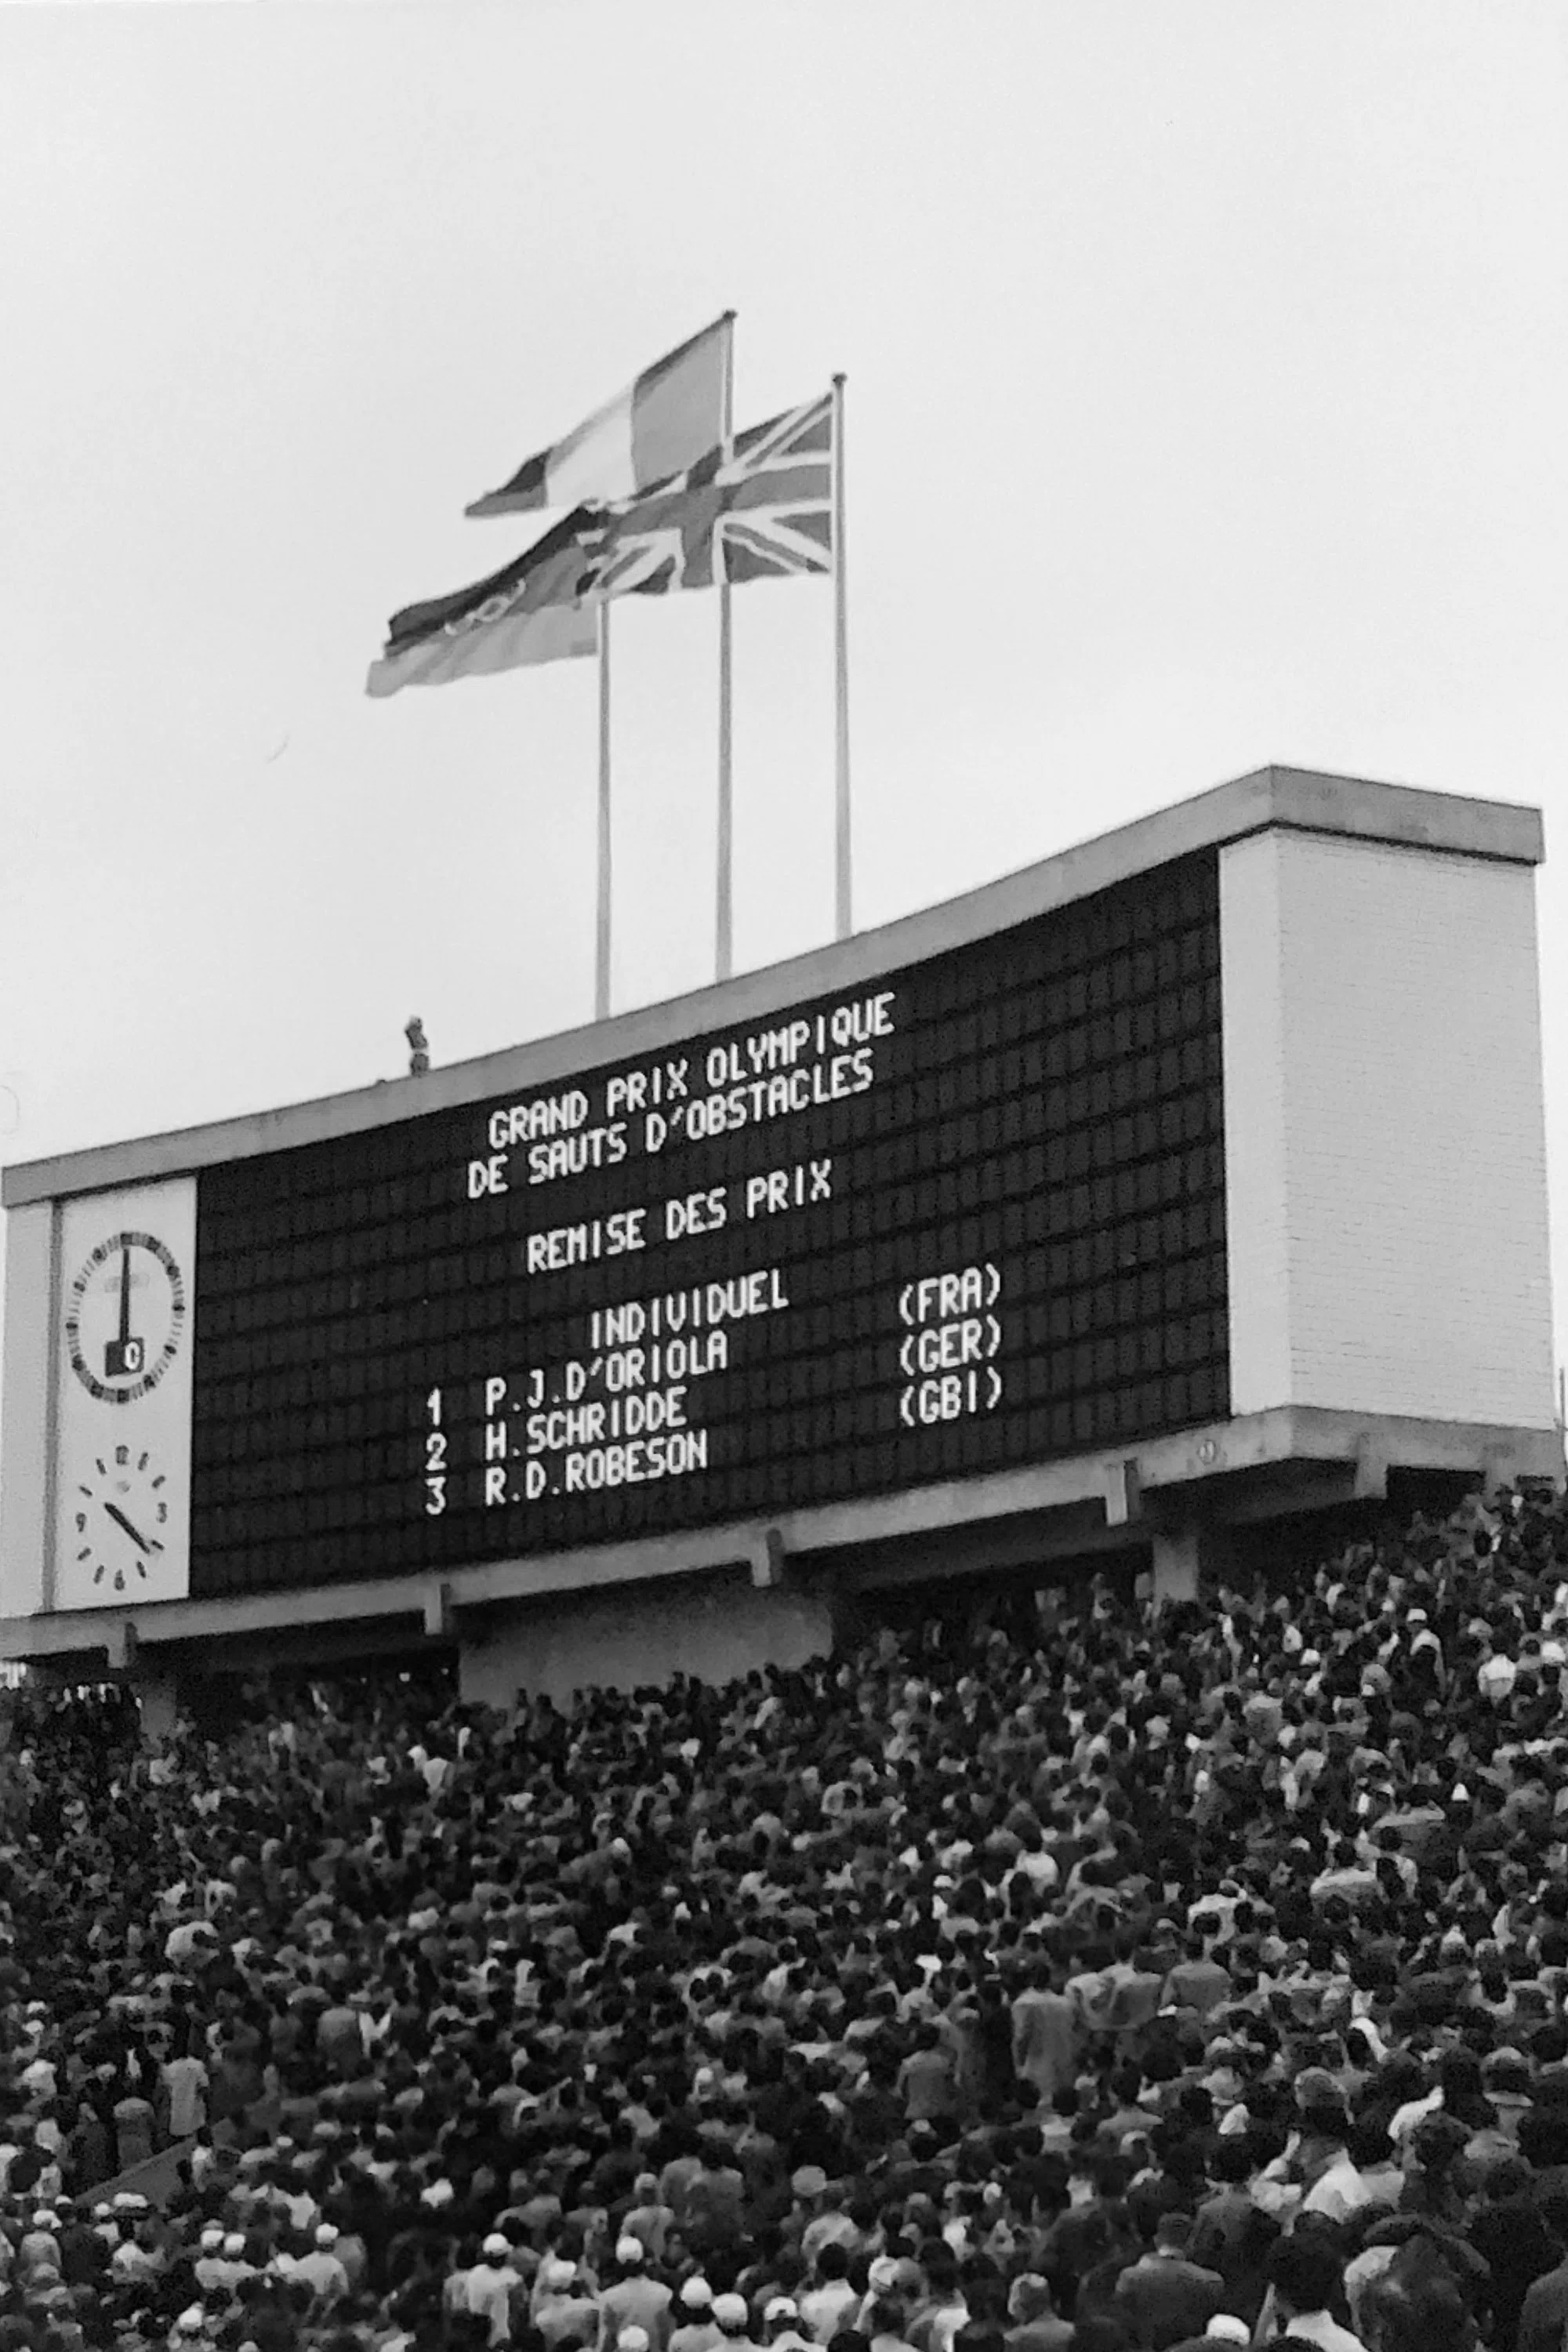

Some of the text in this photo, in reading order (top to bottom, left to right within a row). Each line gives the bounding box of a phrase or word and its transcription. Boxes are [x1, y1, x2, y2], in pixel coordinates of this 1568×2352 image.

[468, 1047, 873, 1199] DE SAUTS D'OBSTACLES
[488, 992, 895, 1149] GRAND PRIX OLYMPIQUE
[527, 1159, 831, 1274] REMISE DES PRIX
[426, 1263, 1000, 1427] 1 P.J.D'ORIOLA (FRA)
[591, 1269, 789, 1349] INDIVIDUEL
[425, 1314, 1001, 1472] 2 H.SCHRIDDE (GER)
[426, 1366, 1002, 1515] 3 R.D.ROBESON (GBI)
